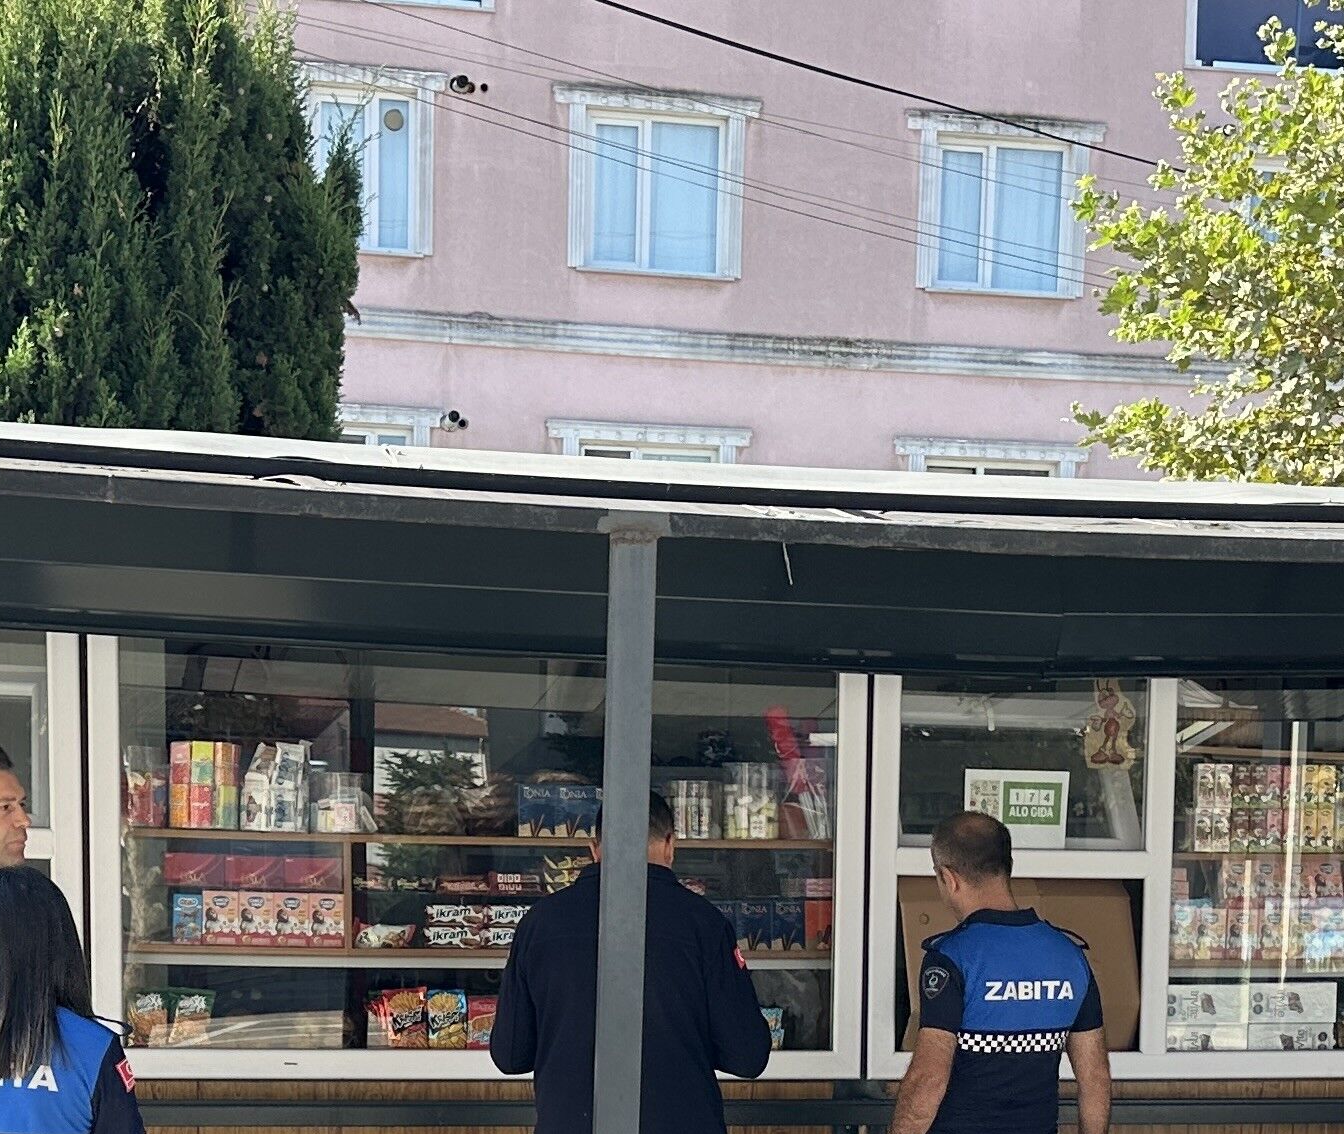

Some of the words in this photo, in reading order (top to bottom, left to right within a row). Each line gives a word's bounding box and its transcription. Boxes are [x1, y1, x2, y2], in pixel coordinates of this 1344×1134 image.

[1009, 806, 1029, 817] ALO
[1030, 806, 1054, 818] GIDA
[984, 980, 1074, 1001] ZABITA
